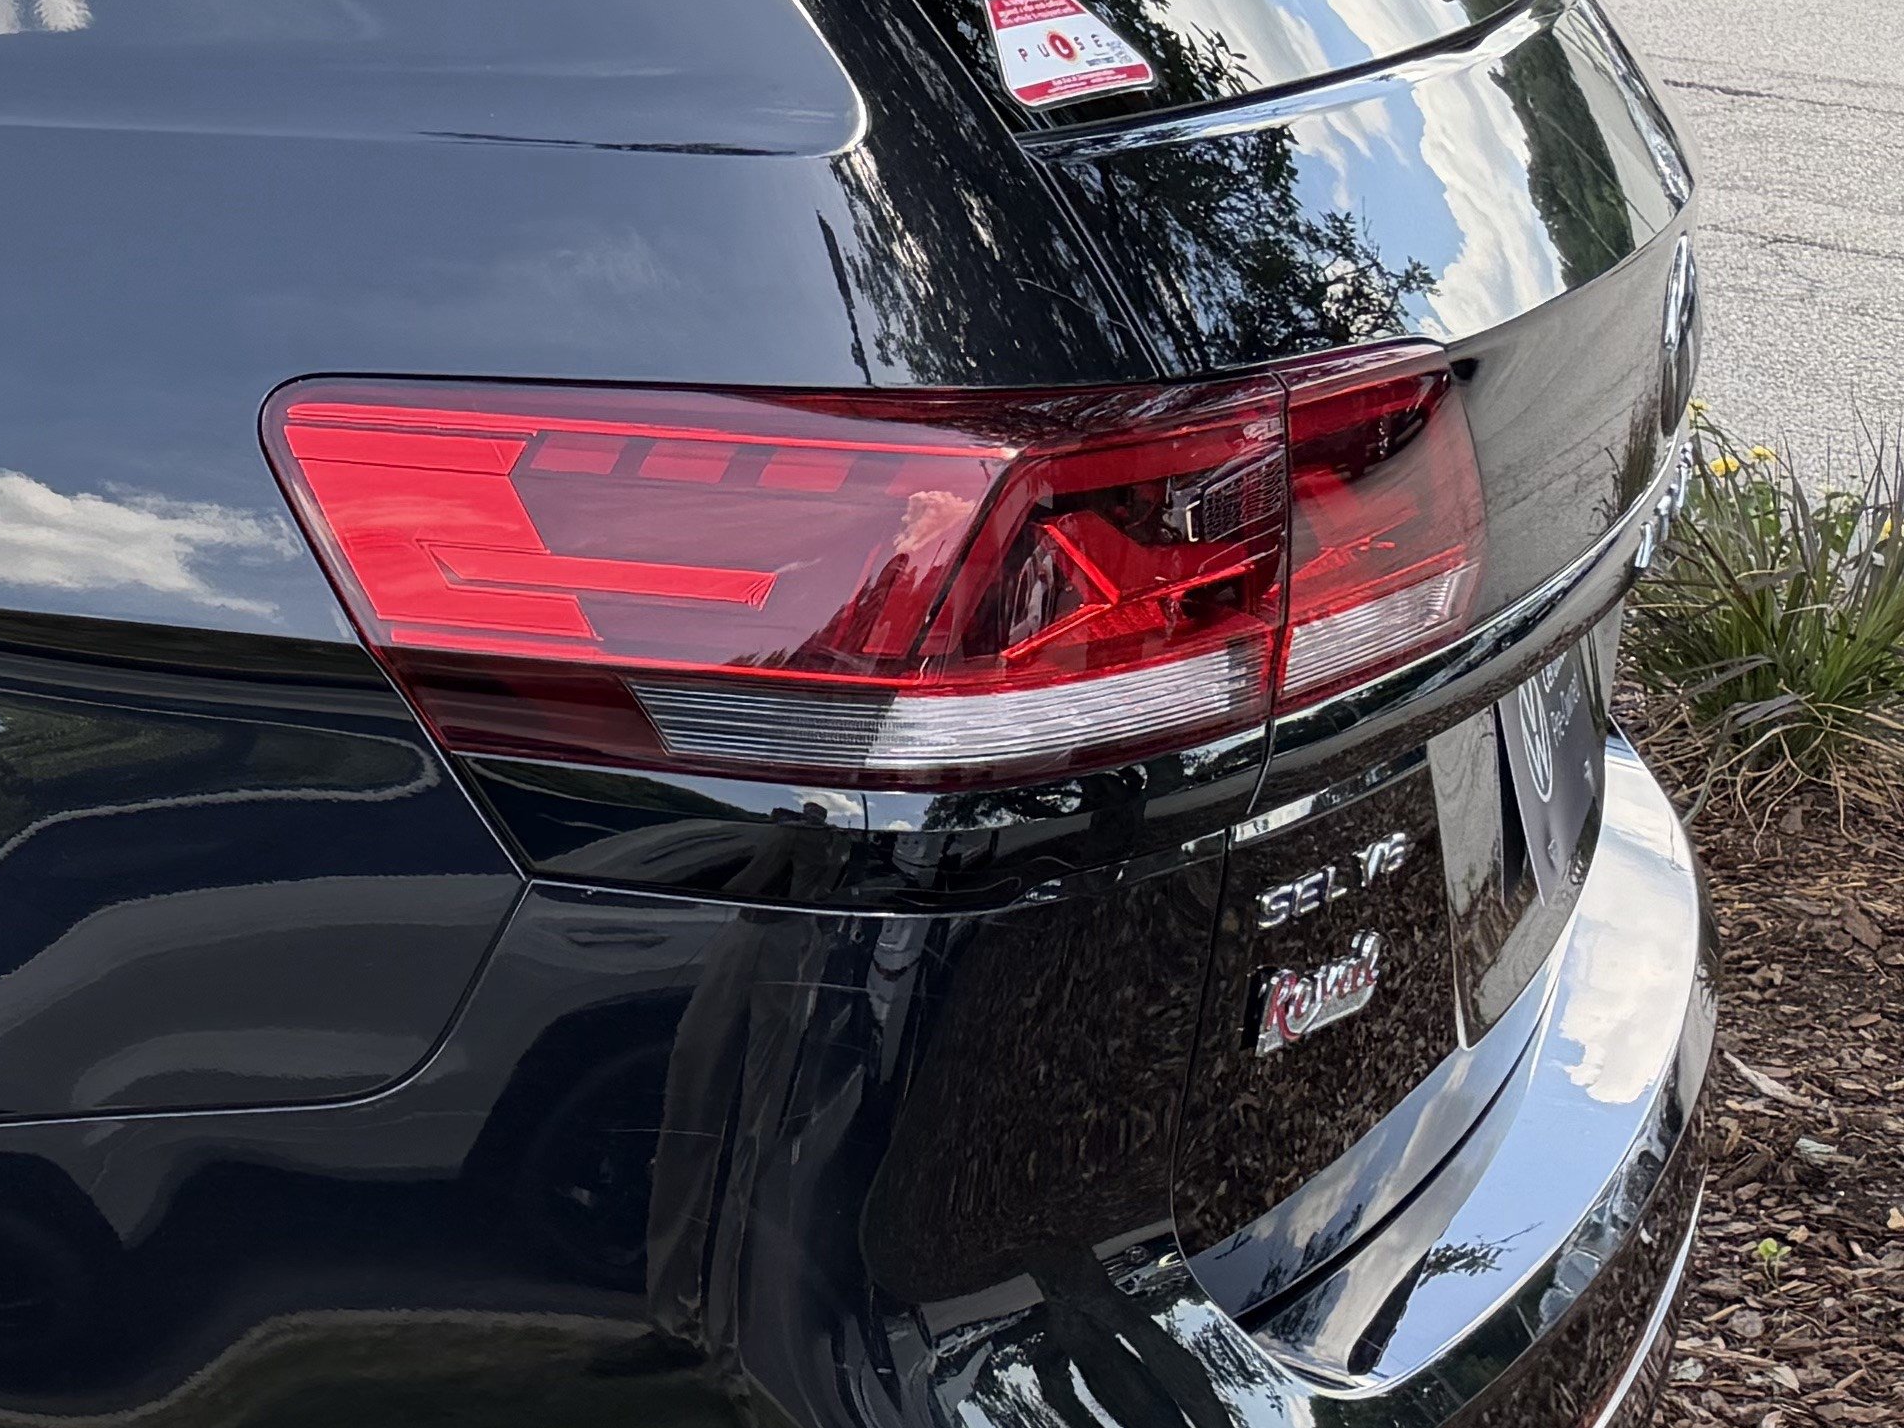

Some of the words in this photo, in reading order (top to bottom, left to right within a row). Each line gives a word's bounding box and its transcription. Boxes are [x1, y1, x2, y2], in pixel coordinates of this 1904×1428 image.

[1017, 32, 1103, 63] PULSE
[1255, 865, 1348, 930] SEL
[1351, 832, 1407, 888] V6
